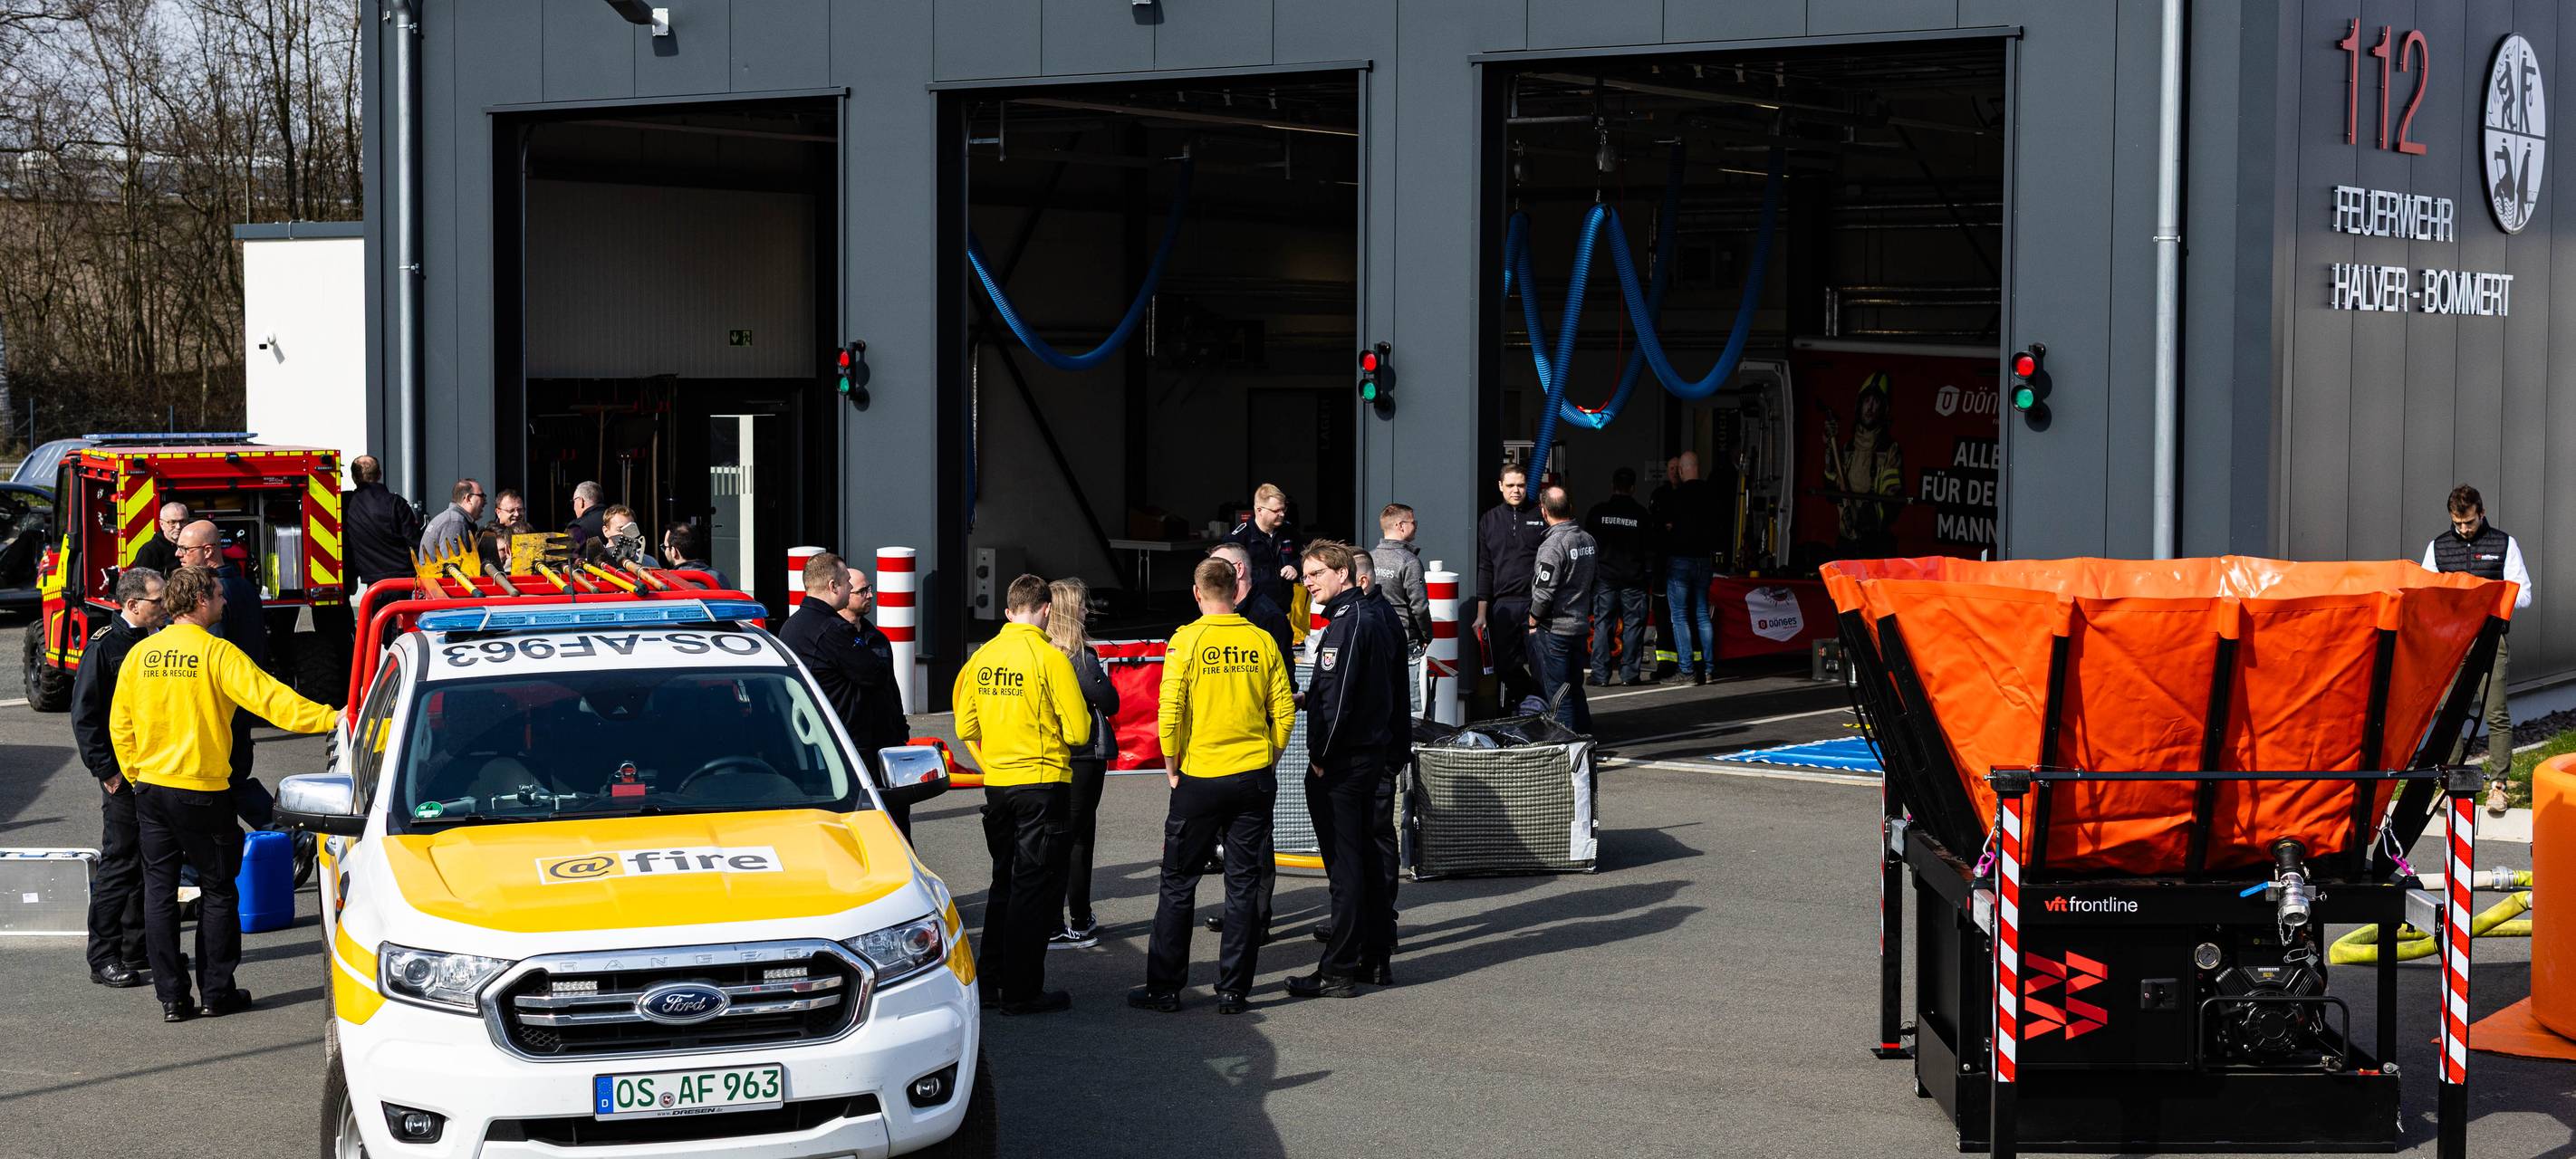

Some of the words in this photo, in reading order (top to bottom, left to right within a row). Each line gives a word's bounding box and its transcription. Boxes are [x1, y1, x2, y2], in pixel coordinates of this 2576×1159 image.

[2340, 18, 2427, 155] 112
[2335, 185, 2454, 243] FEUERWEHR
[2334, 263, 2408, 312] HALVER
[2425, 269, 2514, 316] BOMMERT
[1921, 471, 1961, 504] FÜR
[1967, 479, 1999, 508] DE
[1601, 516, 1638, 527] FEUERWEHR
[144, 649, 198, 668] @fire
[442, 633, 762, 667] OS-AF963
[1202, 646, 1259, 665] @fire
[977, 666, 1024, 686] @fire
[1202, 666, 1220, 675] FIRE
[1231, 666, 1259, 674] RESCUE
[992, 687, 997, 695] &
[1001, 688, 1024, 696] RESCUE
[549, 850, 768, 879] @fire
[2069, 896, 2139, 913] frontline
[560, 947, 803, 972] RANGER
[662, 993, 706, 1013] Ford
[601, 1098, 609, 1107] D
[616, 1078, 655, 1108] OS
[678, 1074, 716, 1105] AF
[724, 1069, 779, 1101] 963
